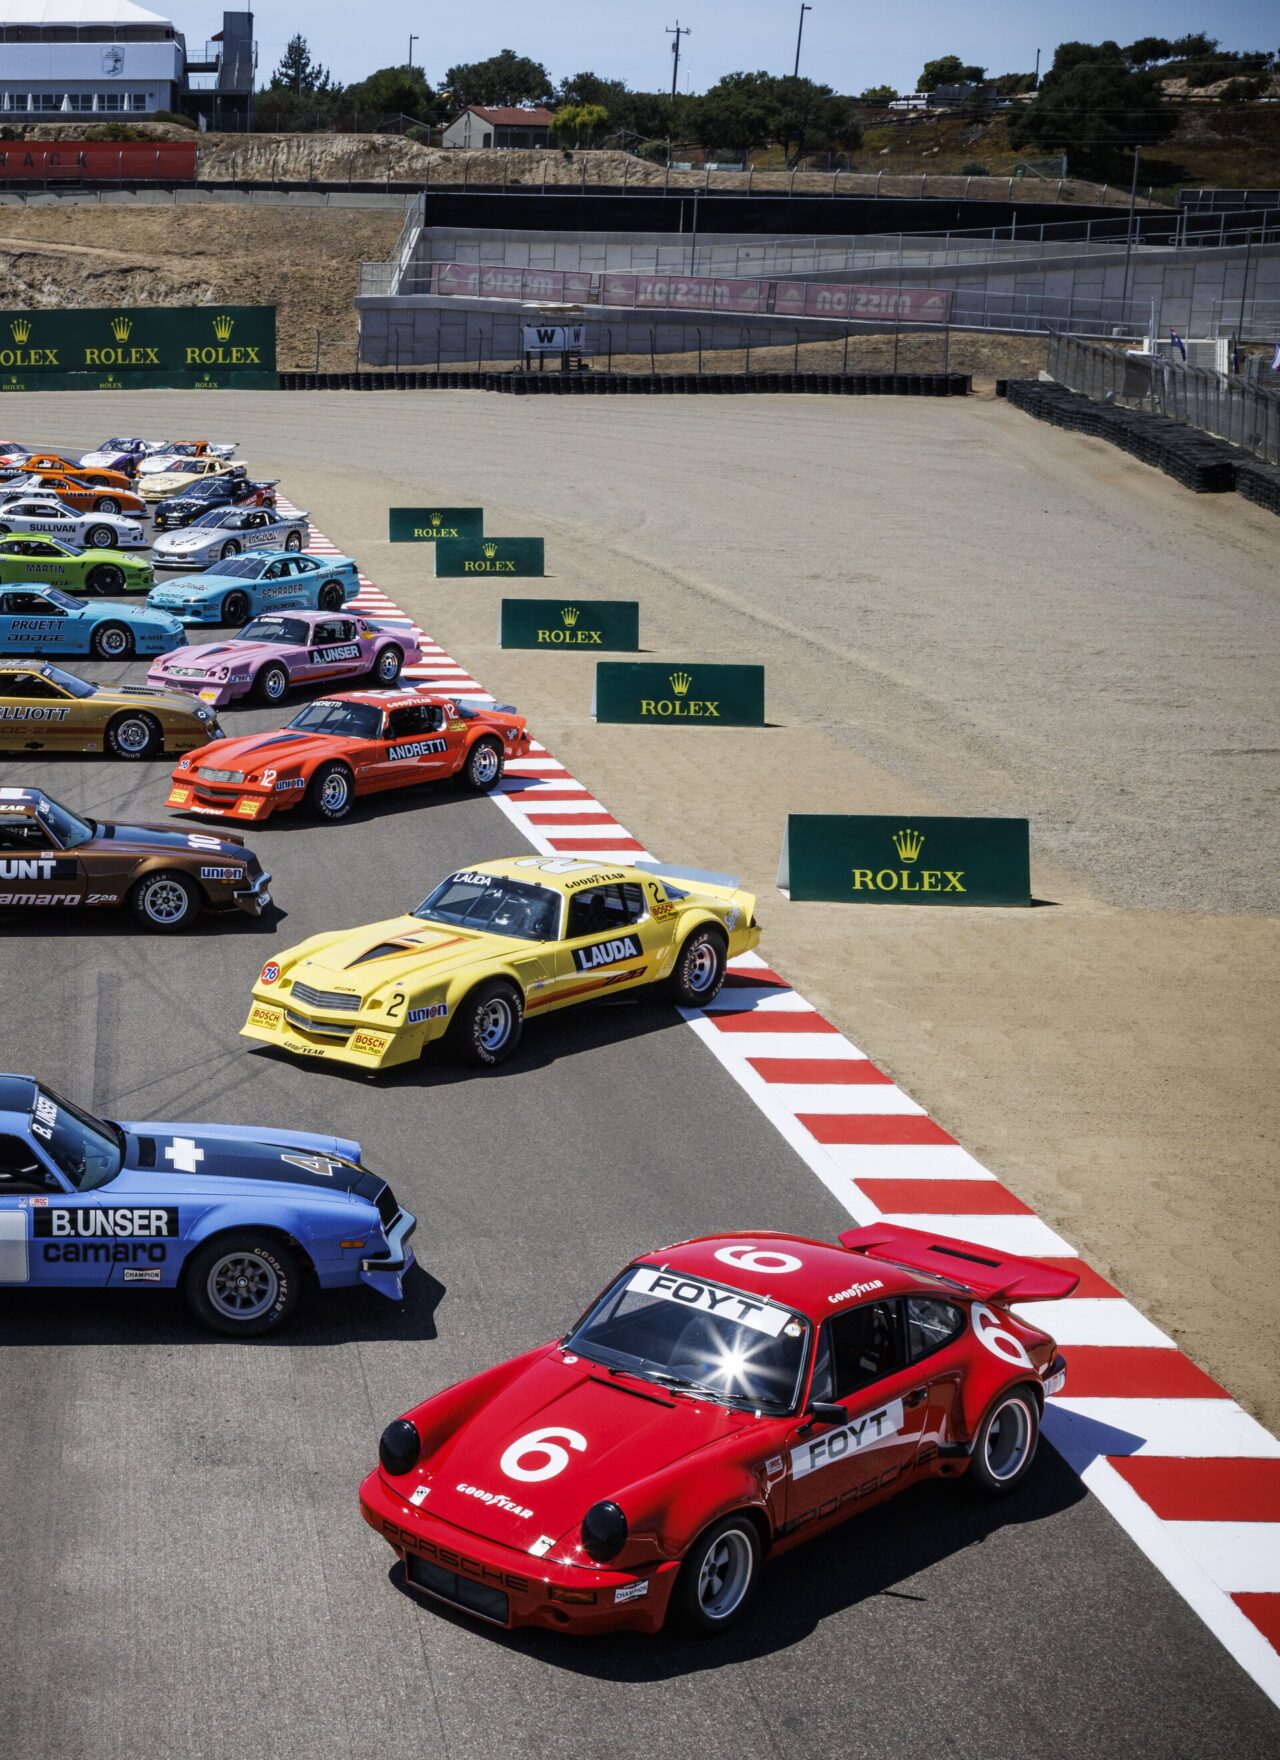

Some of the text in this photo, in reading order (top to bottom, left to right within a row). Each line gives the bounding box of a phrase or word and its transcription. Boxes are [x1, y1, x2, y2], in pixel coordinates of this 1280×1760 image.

[536, 329, 556, 344] W
[84, 348, 161, 365] ROLEX
[185, 347, 261, 364] ROLEX
[195, 381, 218, 389] ROLEX
[29, 523, 77, 533] SULLIVAN
[414, 528, 459, 538] ROLEX
[248, 530, 278, 544] GORDON
[26, 564, 65, 573] MARTIN
[464, 561, 516, 572] ROLEX
[262, 583, 303, 598] SCHRADER
[11, 620, 65, 630] PRUETT
[357, 618, 368, 631] 3
[537, 630, 603, 644] ROLEX
[218, 666, 230, 681] 3
[444, 703, 459, 719] 12
[640, 700, 721, 716] ROLEX
[389, 738, 447, 761] ANDRETTI
[260, 769, 277, 787] 12
[188, 834, 221, 850] 10
[453, 873, 492, 886] LAUDA
[565, 872, 626, 889] GOODYEAR
[852, 869, 967, 892] ROLEX
[86, 893, 118, 904] Z28
[648, 882, 665, 903] 2
[578, 937, 638, 969] LAUDA
[264, 966, 277, 980] 76
[386, 993, 405, 1017] 2
[252, 1009, 281, 1022] BOSCH
[283, 1041, 325, 1056] GOODYEAR
[353, 1041, 381, 1054] Spark Plugs
[355, 1034, 385, 1049] BOSCH
[37, 1096, 58, 1127] UNSER
[281, 1154, 342, 1176] 4
[52, 1209, 168, 1236] B.UNSER
[43, 1242, 167, 1263] camaro
[125, 1271, 160, 1279] CHAMPION
[648, 1275, 764, 1321] FOYT
[828, 1279, 884, 1304] GOODYEAR
[971, 1301, 1034, 1369] 6
[809, 1409, 888, 1470] FOYT
[500, 1426, 588, 1482] 6
[792, 1449, 940, 1531] PORSCHE
[456, 1483, 534, 1520] GOODYEAR
[382, 1522, 529, 1593] PORSCHE
[616, 1585, 647, 1600] CHAMPION
